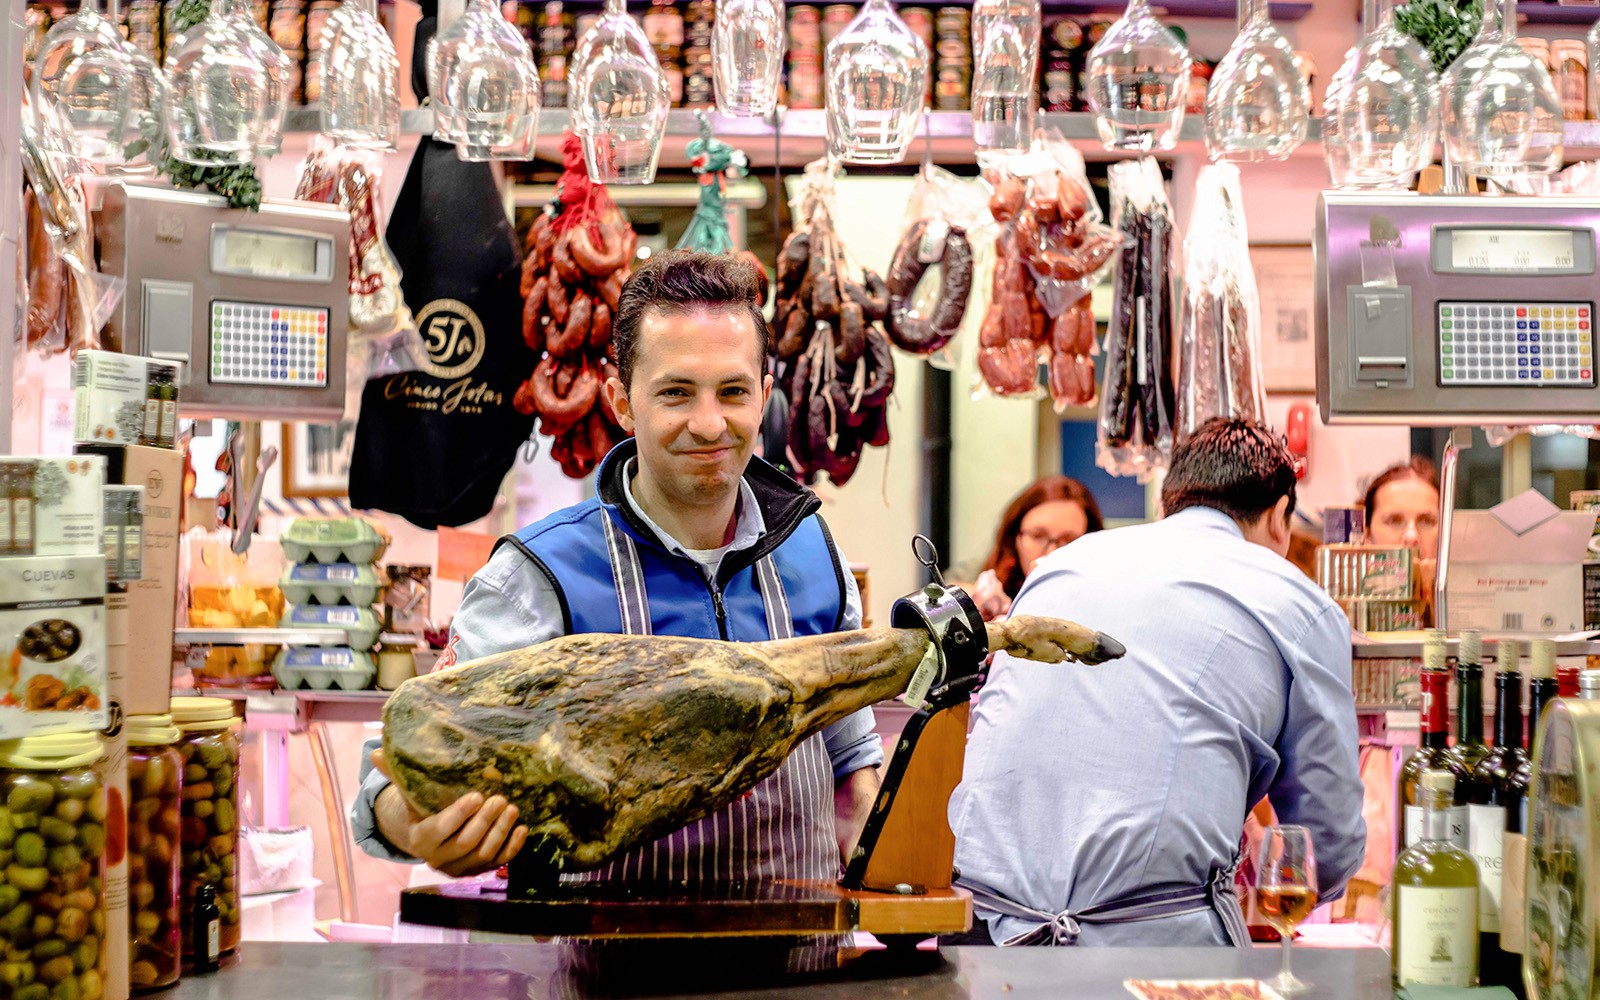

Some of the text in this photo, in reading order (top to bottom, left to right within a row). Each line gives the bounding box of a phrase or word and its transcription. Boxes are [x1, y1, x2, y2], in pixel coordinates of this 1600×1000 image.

[384, 375, 502, 414] Cinco Jotas
[22, 569, 75, 582] CUEVAS
